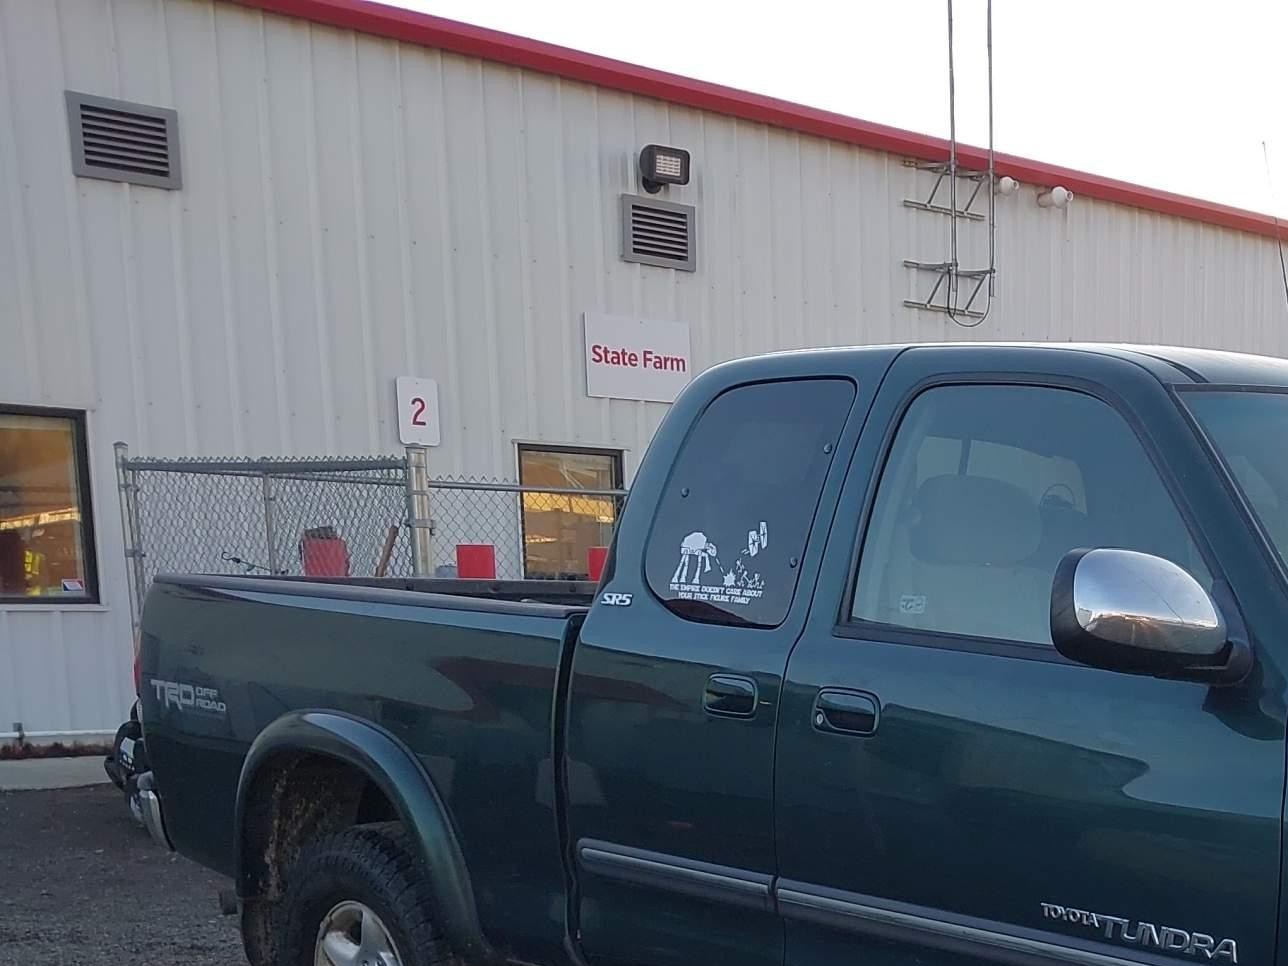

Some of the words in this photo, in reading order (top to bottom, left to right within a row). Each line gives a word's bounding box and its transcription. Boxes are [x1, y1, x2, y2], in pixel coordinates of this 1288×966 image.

[591, 344, 638, 367] State
[642, 350, 686, 372] Farm
[411, 397, 427, 426] 2
[600, 592, 633, 606] SR5
[730, 596, 751, 605] FAMILY
[742, 590, 763, 598] ABOUT
[150, 679, 195, 712] TRD
[195, 687, 218, 697] OFF
[195, 698, 227, 713] ROAD
[1040, 902, 1100, 928] TOYOTA
[1098, 914, 1239, 964] TUNDRA
